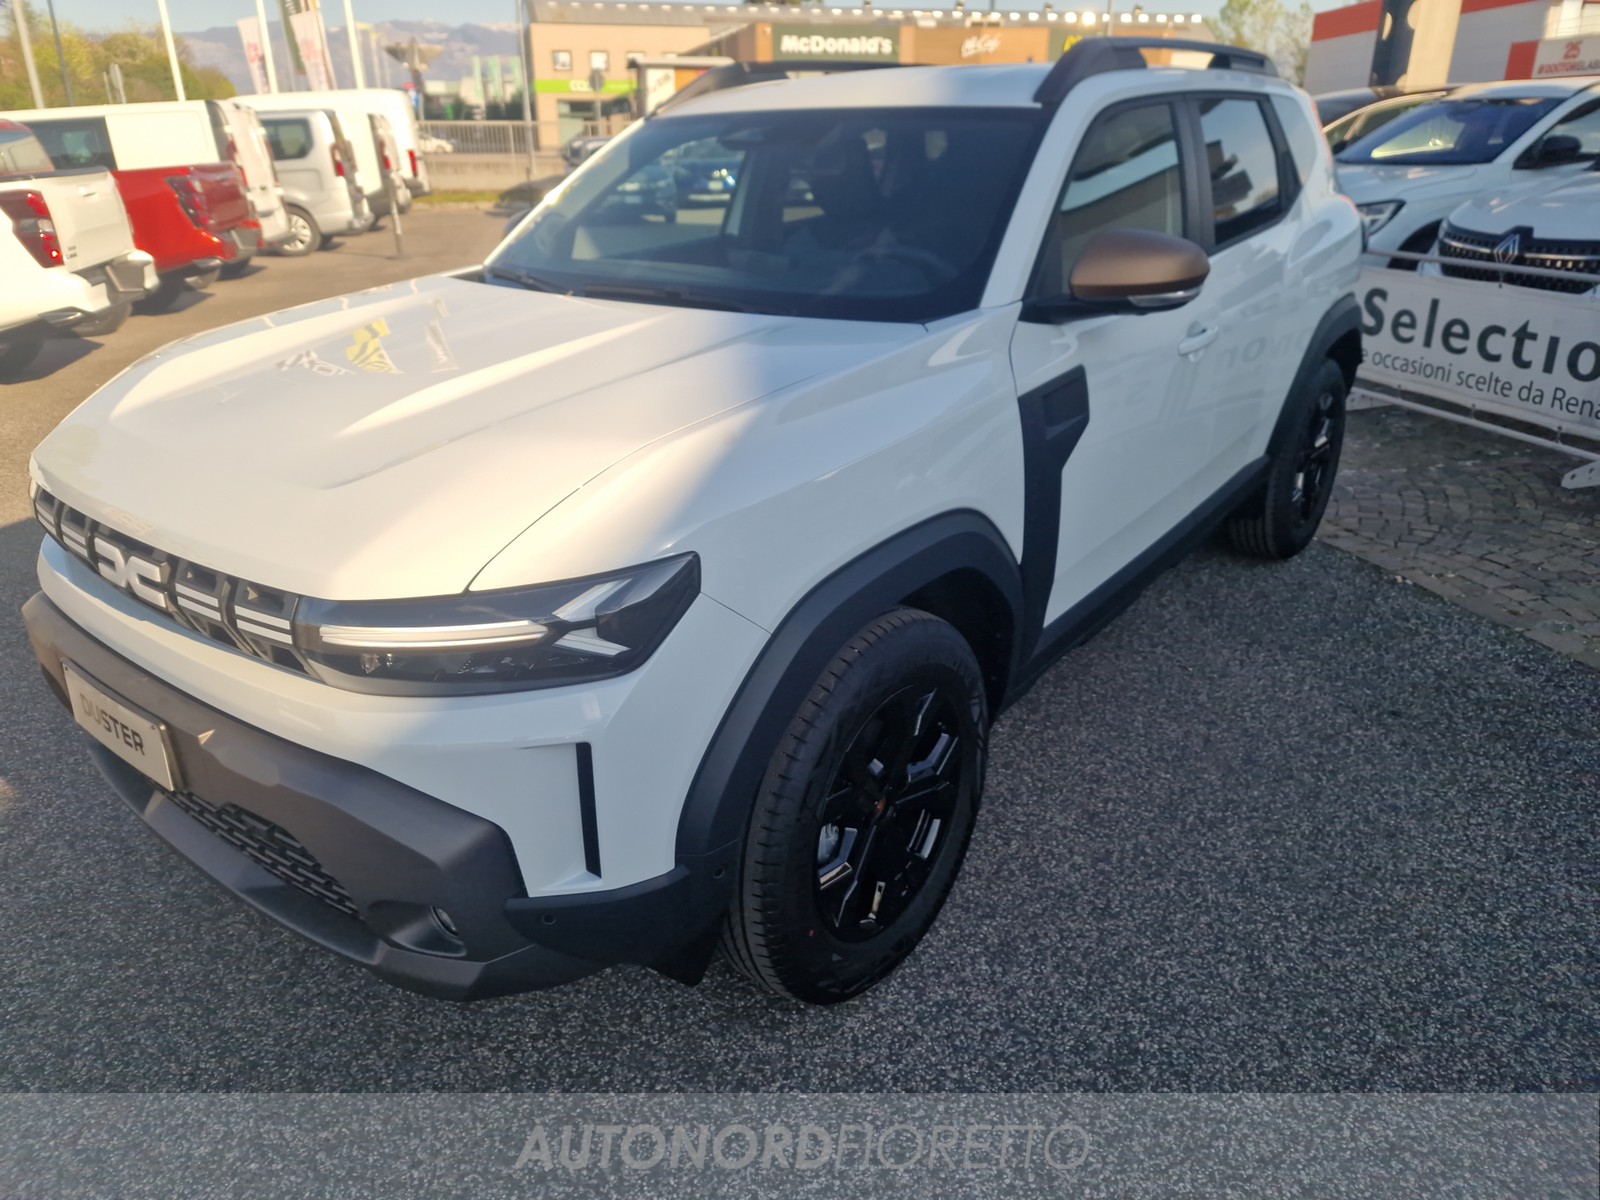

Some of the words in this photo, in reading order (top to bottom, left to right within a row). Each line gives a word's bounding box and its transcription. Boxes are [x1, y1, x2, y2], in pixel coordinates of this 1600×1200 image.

[780, 34, 893, 54] McDonald's
[1372, 350, 1453, 383] occasioni
[1455, 370, 1513, 398] scelte
[1517, 380, 1544, 406] da
[80, 692, 146, 756] DUSTER
